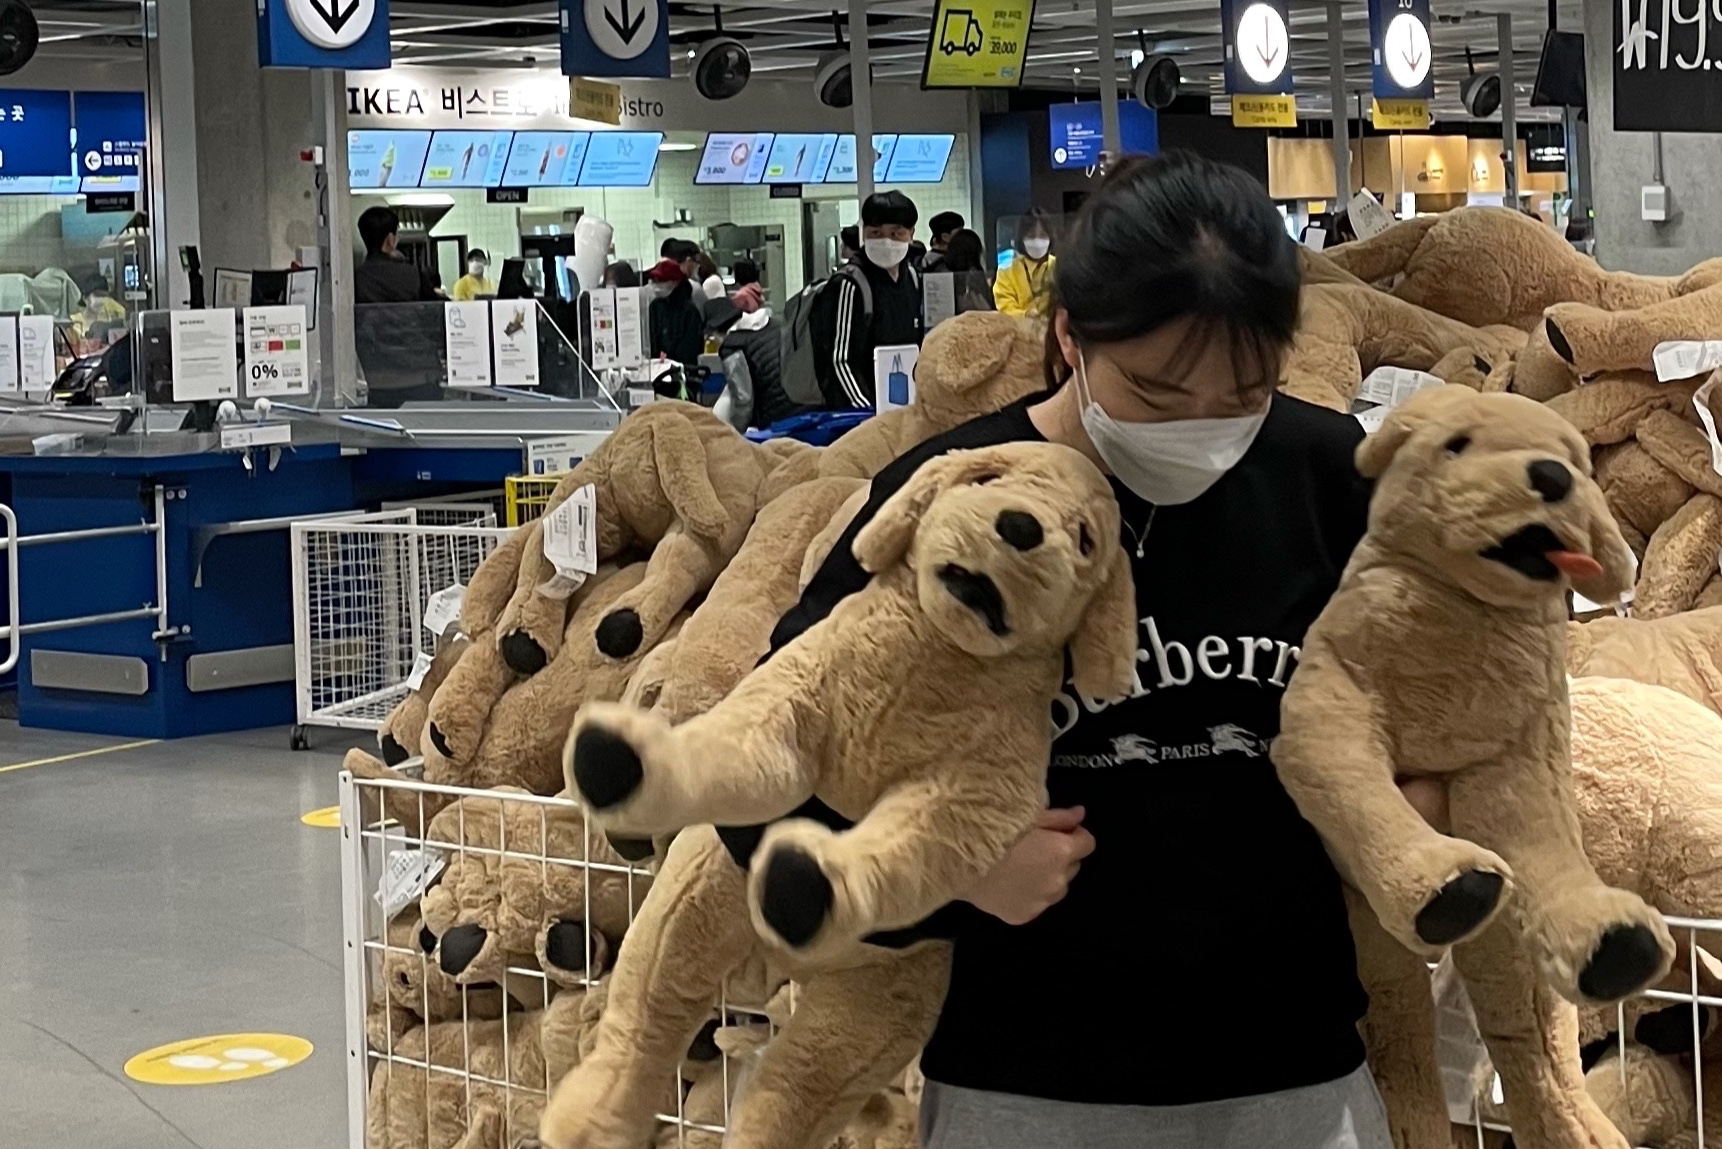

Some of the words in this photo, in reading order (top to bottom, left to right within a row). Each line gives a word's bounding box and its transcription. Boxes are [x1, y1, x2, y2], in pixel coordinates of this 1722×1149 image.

[347, 88, 424, 115] IKEA
[619, 96, 664, 117] istro
[496, 190, 520, 201] OPEN
[251, 364, 279, 380] 0%
[1053, 752, 1116, 768] ONDON
[1160, 743, 1211, 760] PARIS
